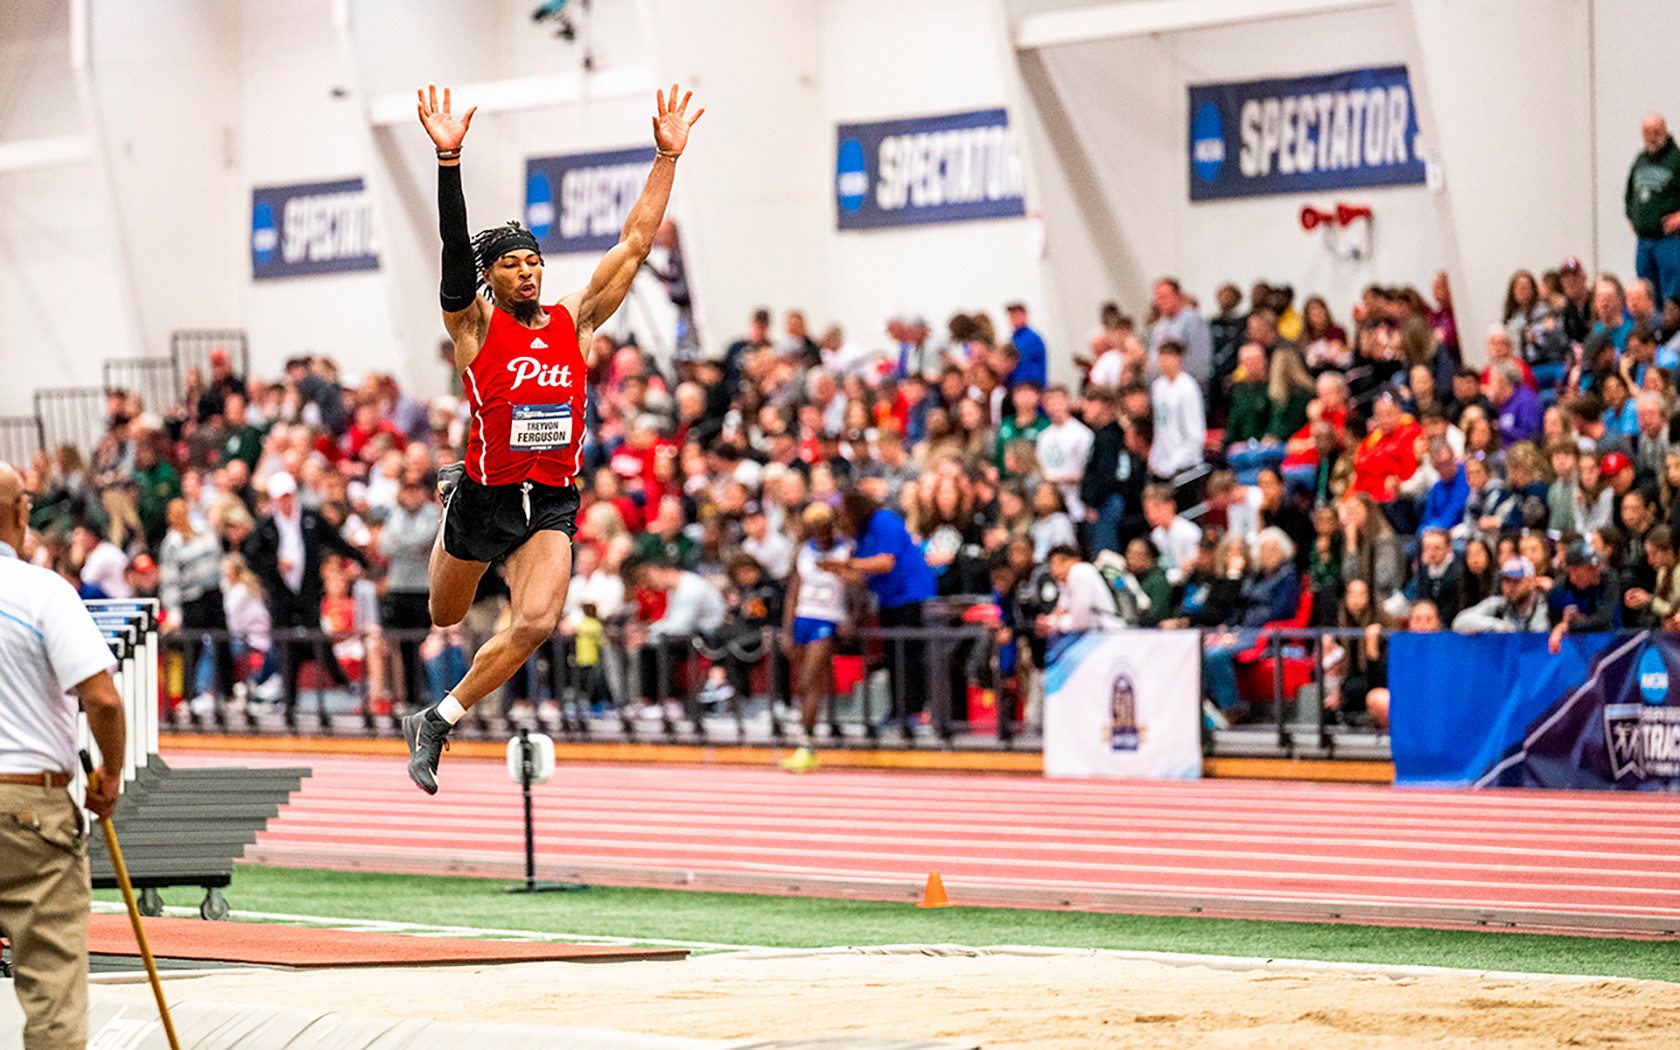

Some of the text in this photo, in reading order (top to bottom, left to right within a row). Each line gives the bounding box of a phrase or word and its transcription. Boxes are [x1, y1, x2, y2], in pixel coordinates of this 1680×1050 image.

[1238, 85, 1409, 178] SPECTATOR
[507, 356, 573, 391] Pitt
[517, 430, 566, 443] FERGUSON
[527, 421, 559, 431] TREYVON
